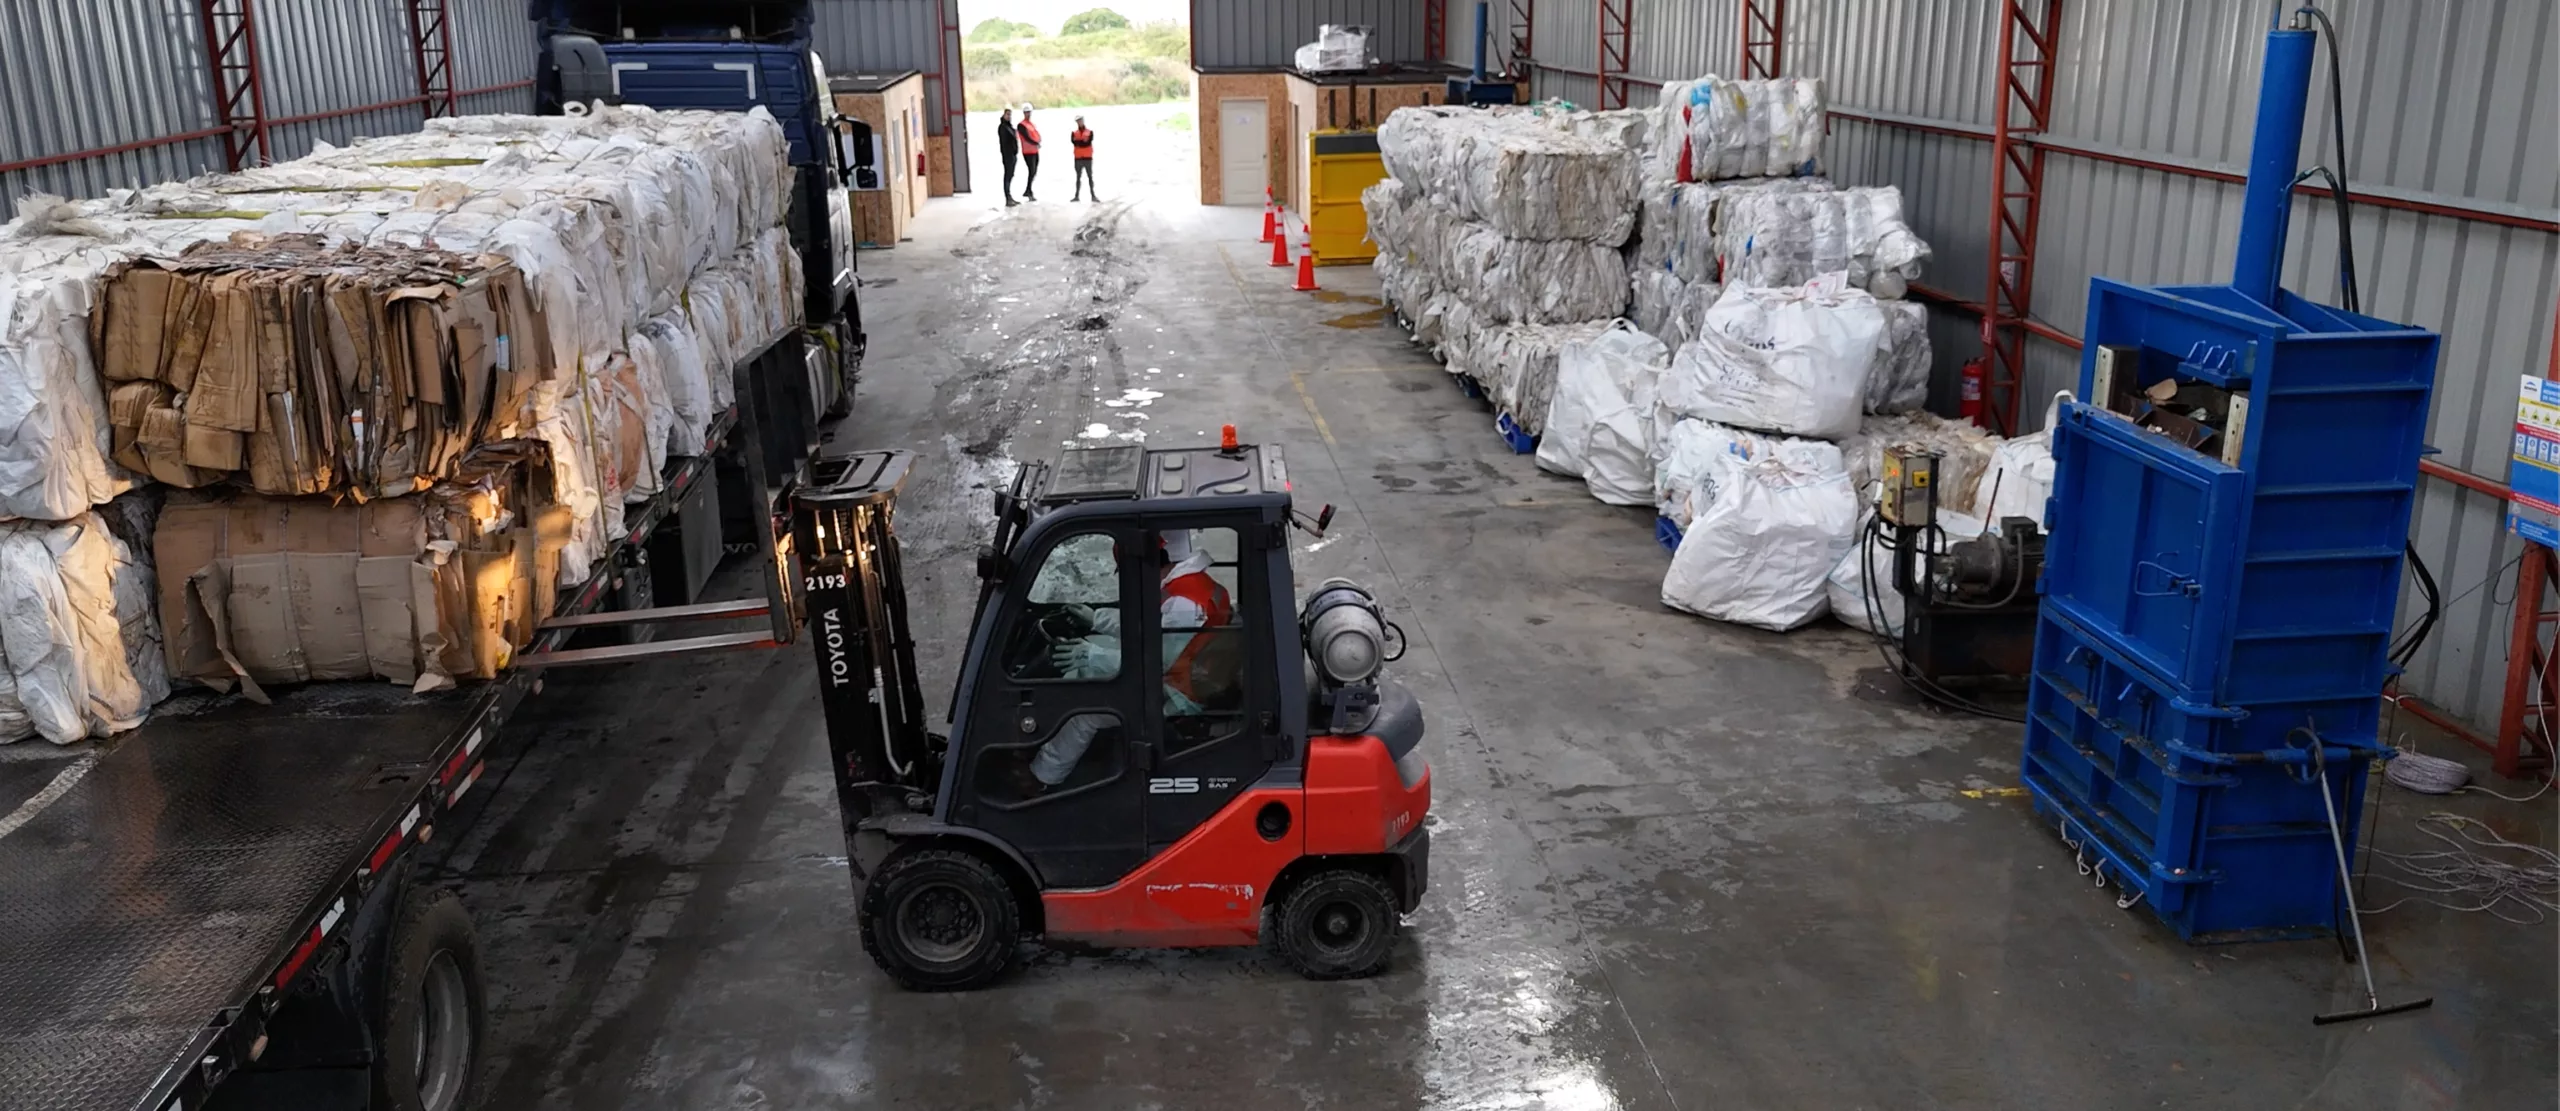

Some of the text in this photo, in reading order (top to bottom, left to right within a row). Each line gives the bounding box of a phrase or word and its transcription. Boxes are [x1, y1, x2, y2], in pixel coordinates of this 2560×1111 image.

[805, 573, 846, 591] 2193
[823, 607, 849, 688] TOYOTA
[1149, 777, 1200, 794] 25
